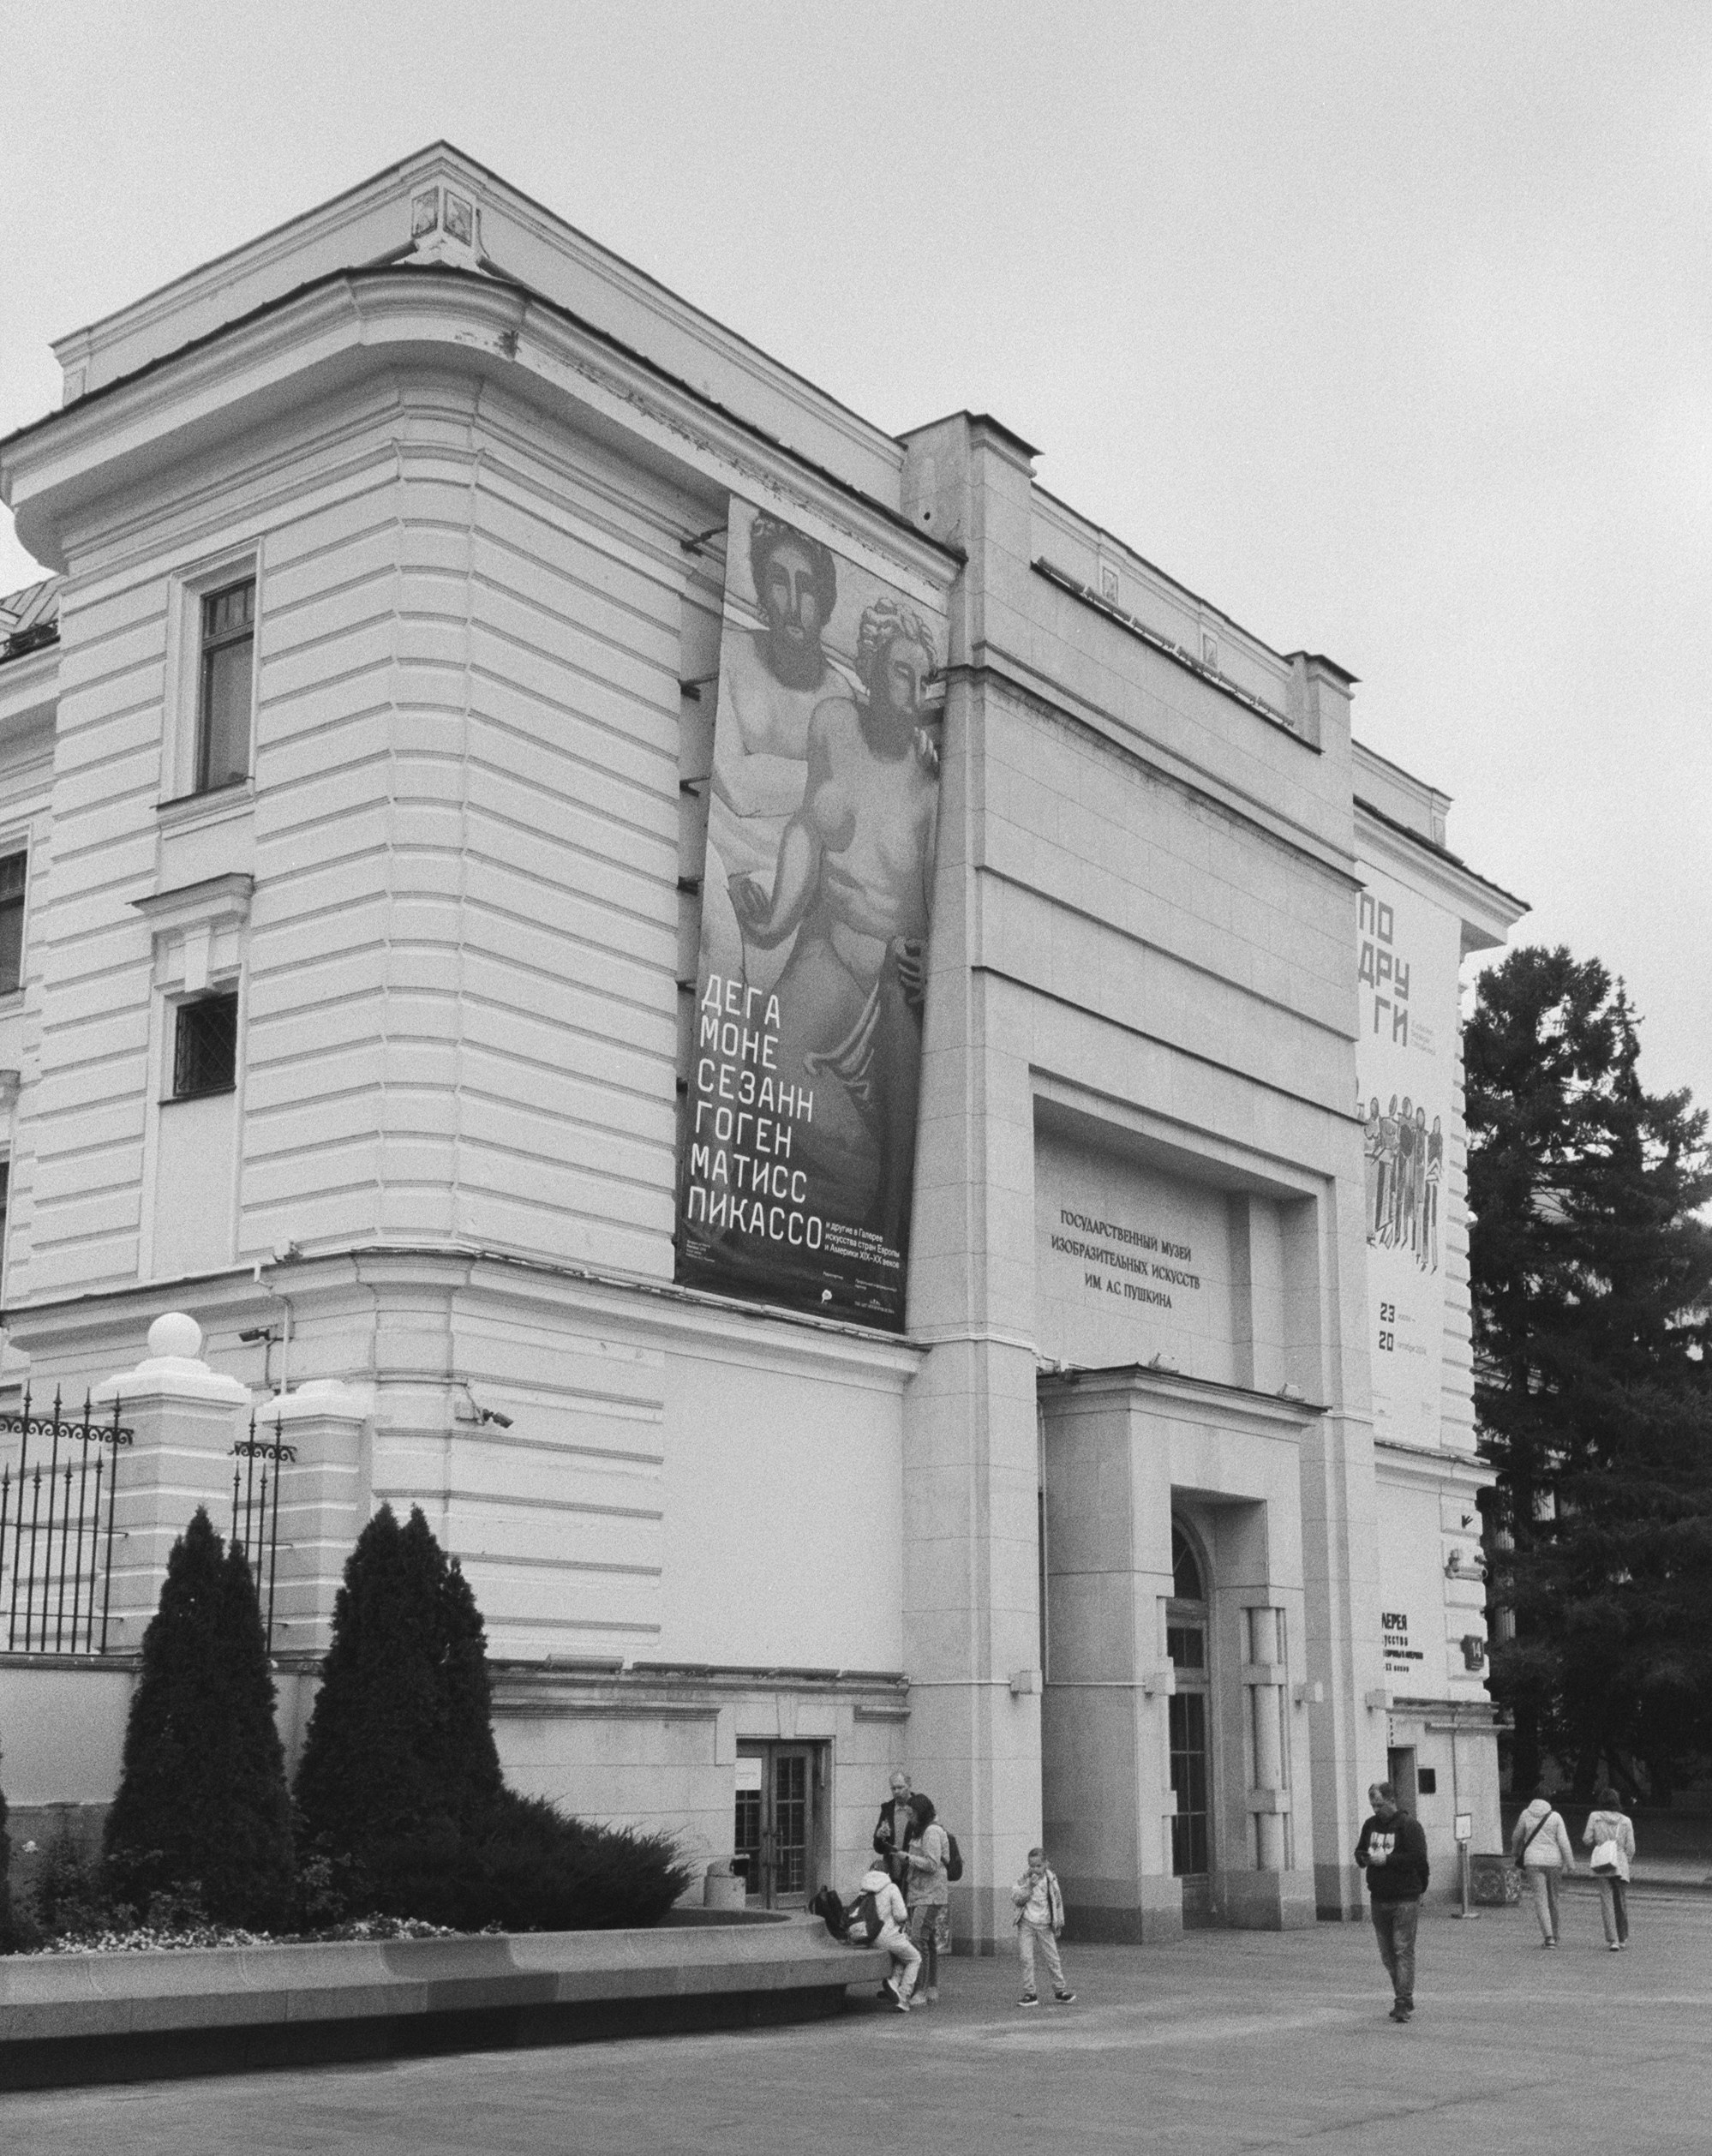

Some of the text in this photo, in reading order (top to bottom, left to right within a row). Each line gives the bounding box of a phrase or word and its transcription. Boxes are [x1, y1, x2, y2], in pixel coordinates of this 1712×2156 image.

[701, 974, 781, 1028] ДЕГА
[700, 1015, 778, 1069] МОНЕ
[697, 1058, 813, 1122] СЕЗАНН
[696, 1101, 792, 1158] ГОГЕН
[691, 1143, 806, 1202] МАТИСС
[688, 1187, 822, 1249] ПИКАССО
[830, 1223, 853, 1235] другие
[859, 1228, 883, 1243] Галерее
[1061, 1210, 1191, 1262] ГОСУДАРСТВЕННЫЙ МУЗЕЙ
[825, 1233, 900, 1258] искусства стран Европы
[830, 1243, 859, 1258] Америки
[883, 1259, 900, 1269] веков
[1051, 1236, 1200, 1290] ИЗОБРАЗИТЕЛЬНЫХ ИСКУССТВ
[1124, 1284, 1172, 1309] ПУШКИНА
[1380, 1303, 1395, 1323] 23
[1379, 1331, 1393, 1352] 20
[1472, 1642, 1482, 1658] 14
